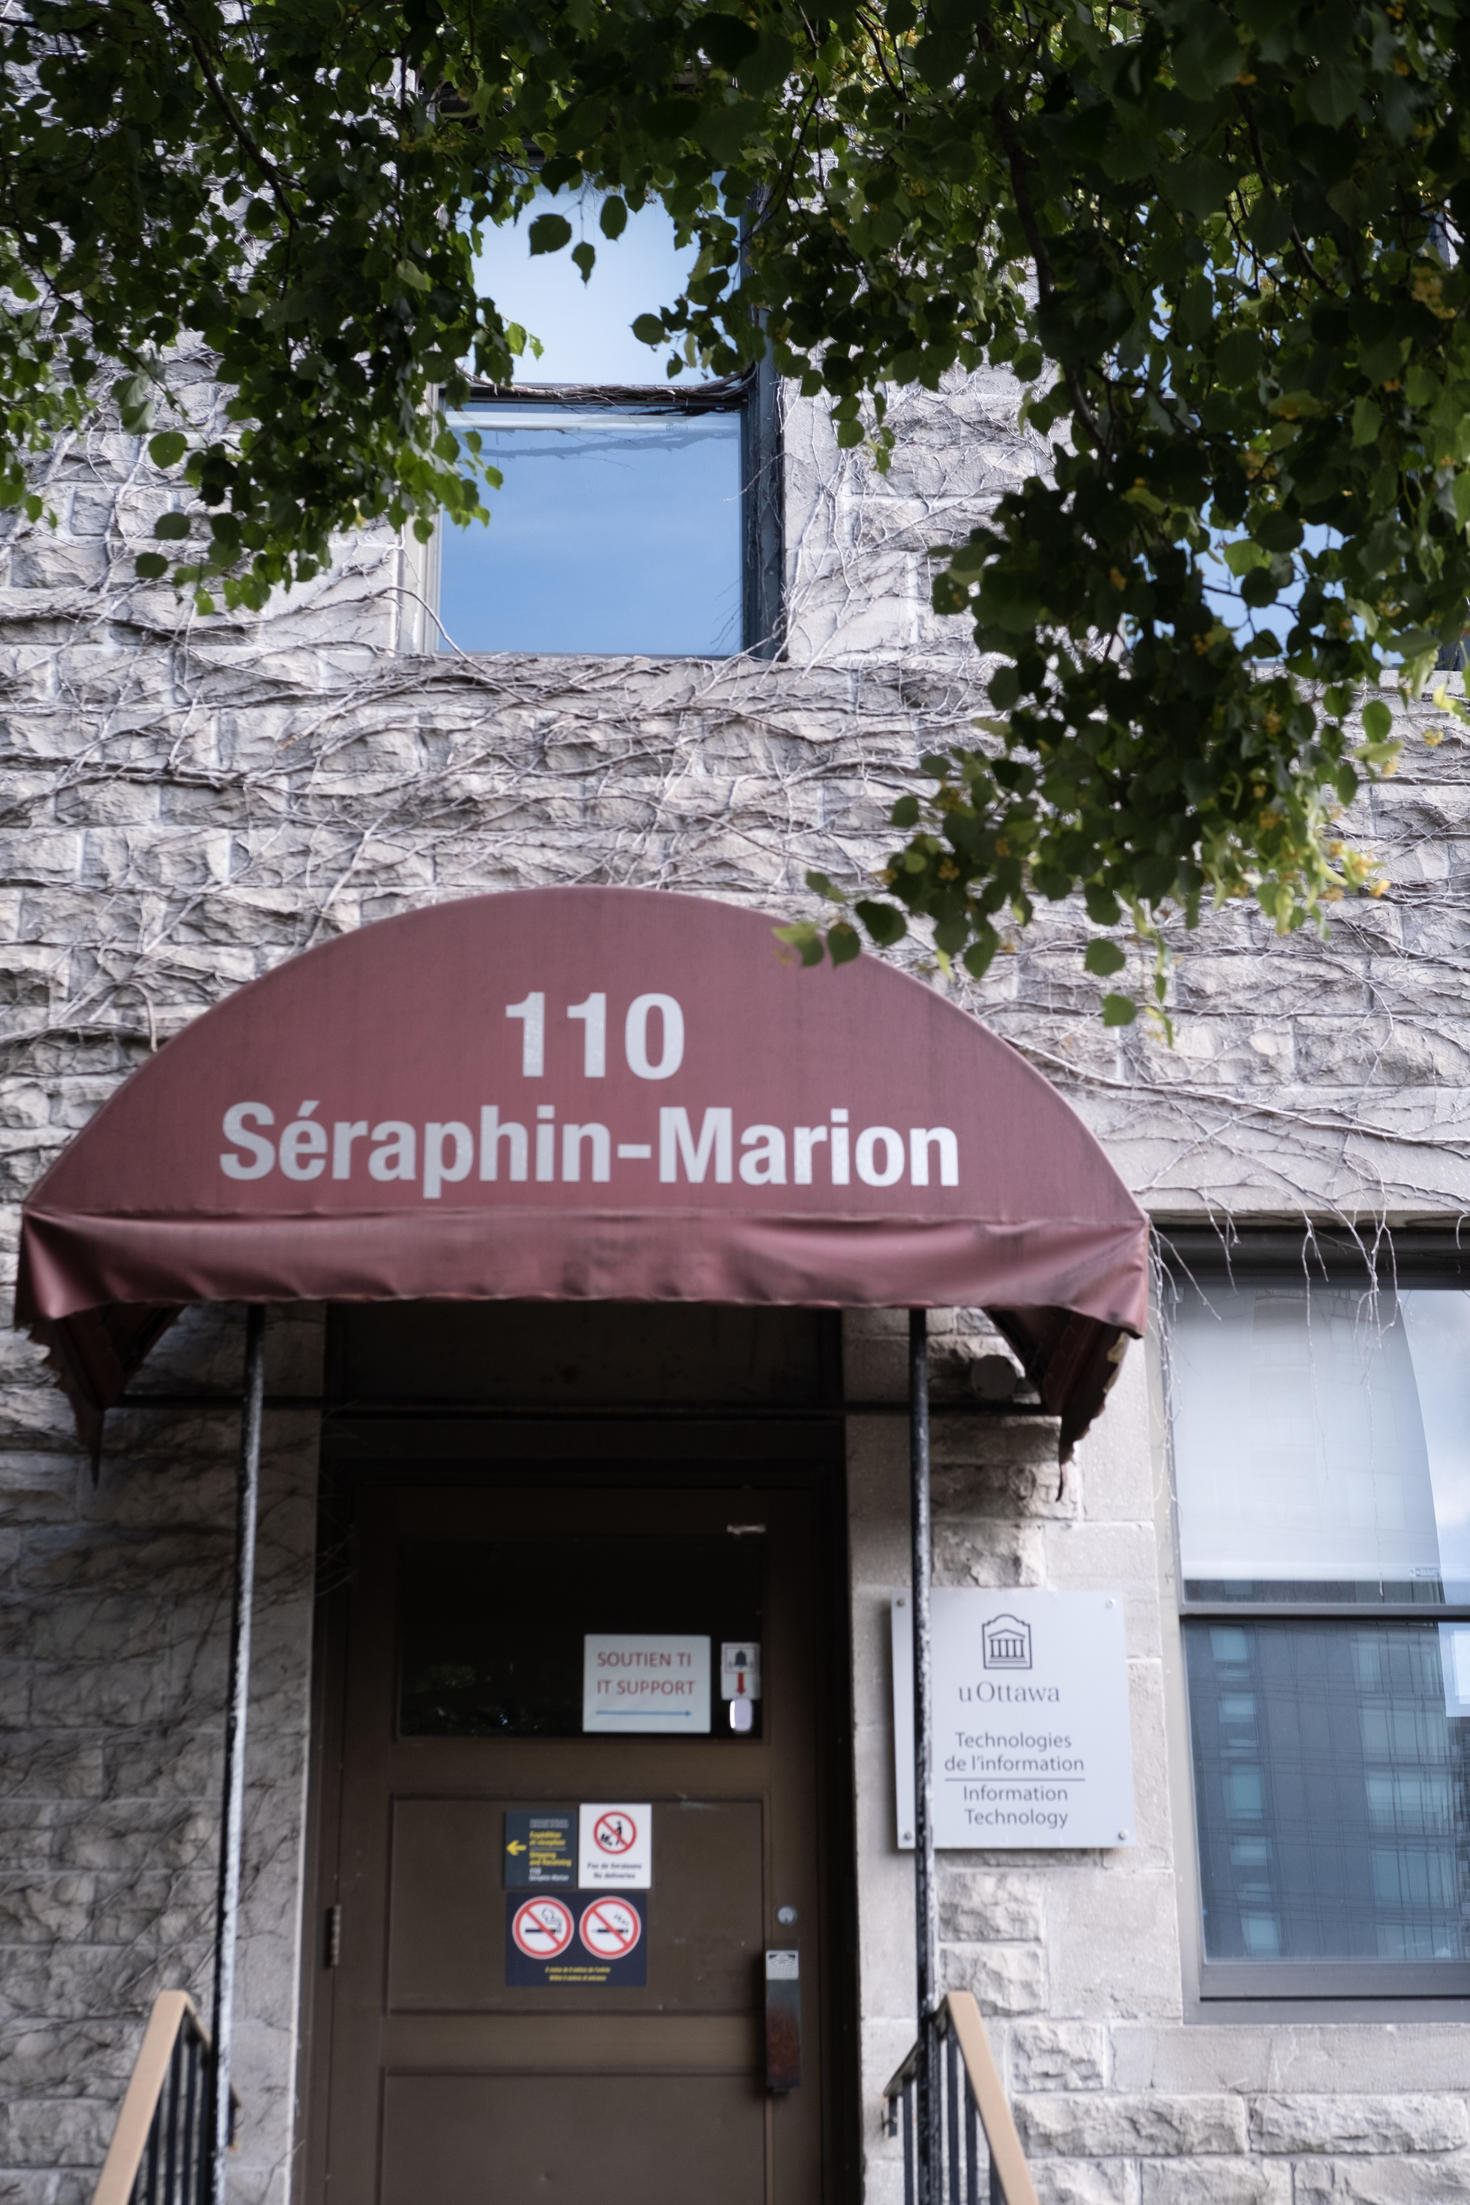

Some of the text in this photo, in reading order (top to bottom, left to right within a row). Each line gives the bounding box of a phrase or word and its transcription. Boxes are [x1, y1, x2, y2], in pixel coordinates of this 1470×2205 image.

[505, 991, 685, 1081] 110
[219, 1100, 960, 1199] Séraphin-Marion
[597, 1651, 692, 1668] SOUTIEN TI
[597, 1680, 696, 1695] IT SUPPORT
[958, 1681, 1061, 1703] uOttawa
[955, 1731, 1072, 1752] Technologies
[944, 1754, 1085, 1772] de l'information
[963, 1784, 1069, 1801] Information
[965, 1808, 1069, 1829] Technology
